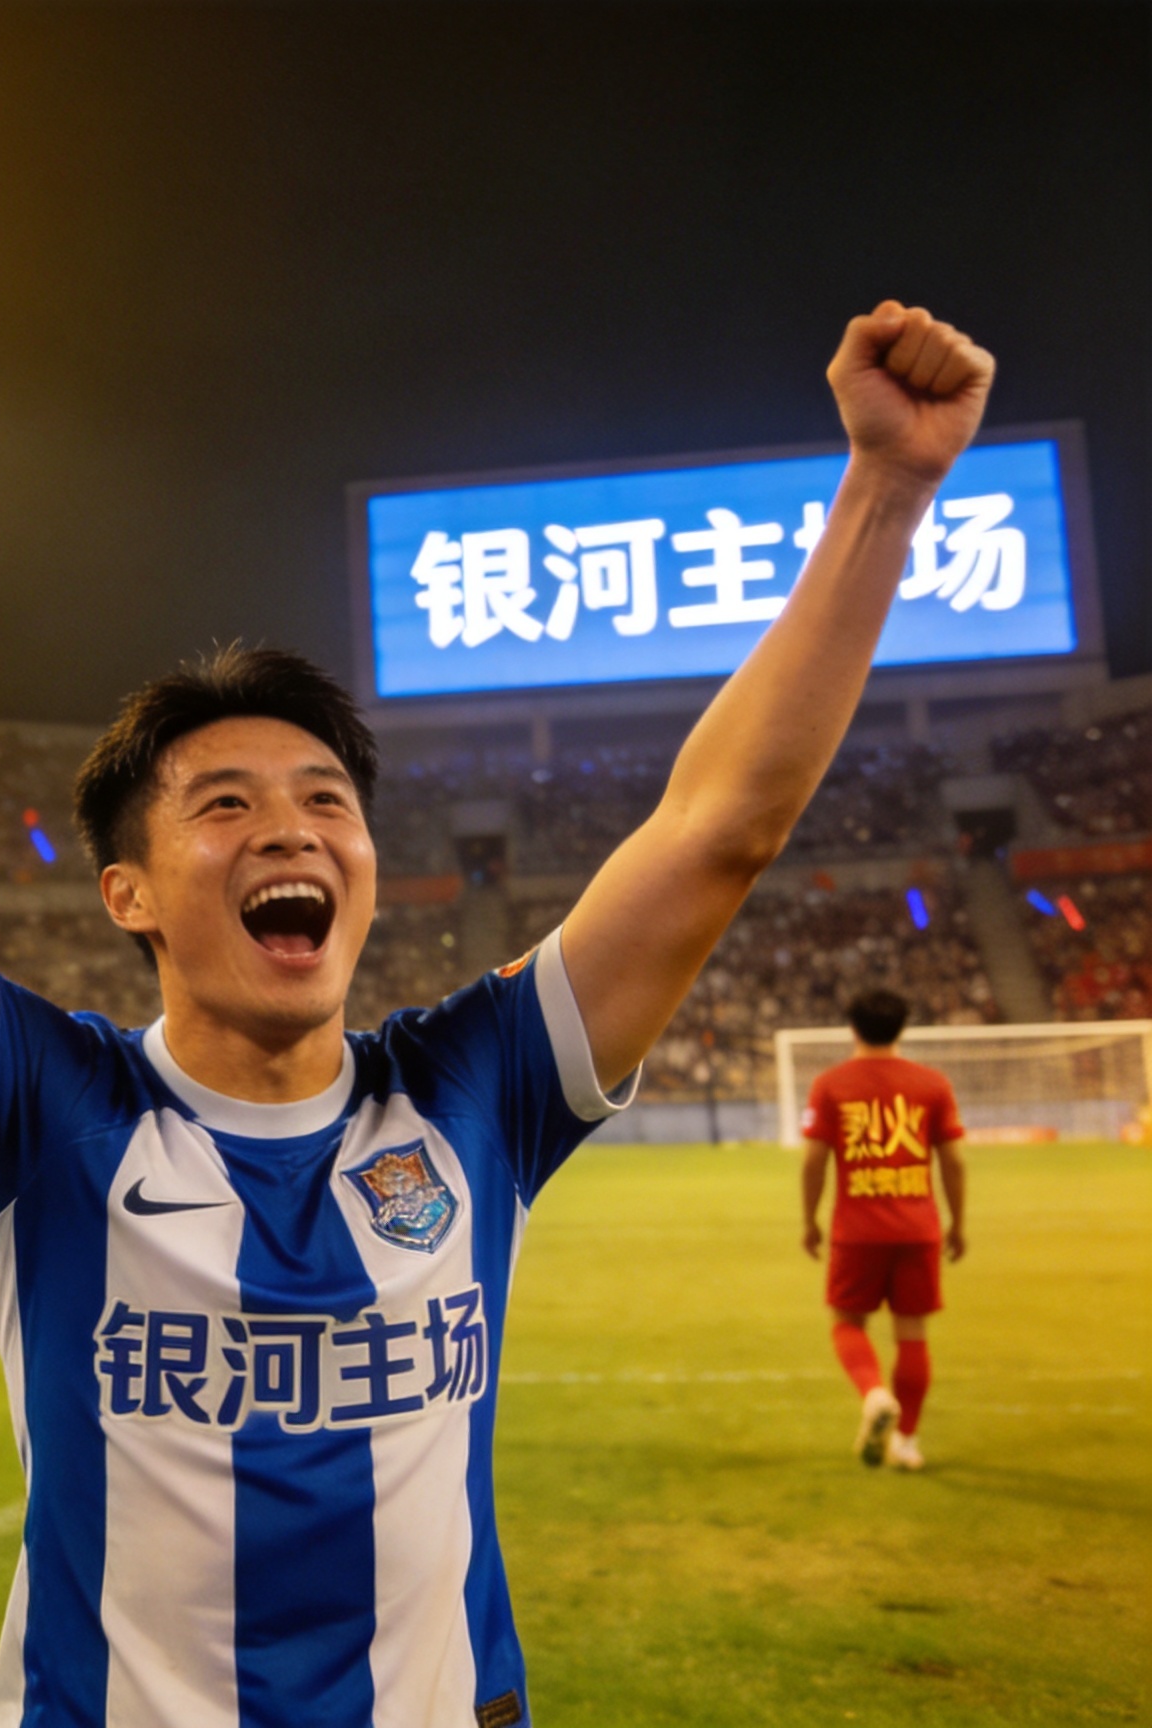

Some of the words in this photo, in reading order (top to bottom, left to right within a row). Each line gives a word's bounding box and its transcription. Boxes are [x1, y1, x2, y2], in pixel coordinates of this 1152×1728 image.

[410, 492, 1026, 648] 银河主场
[840, 1093, 927, 1161] 烈火
[94, 1283, 488, 1433] 银河主场
